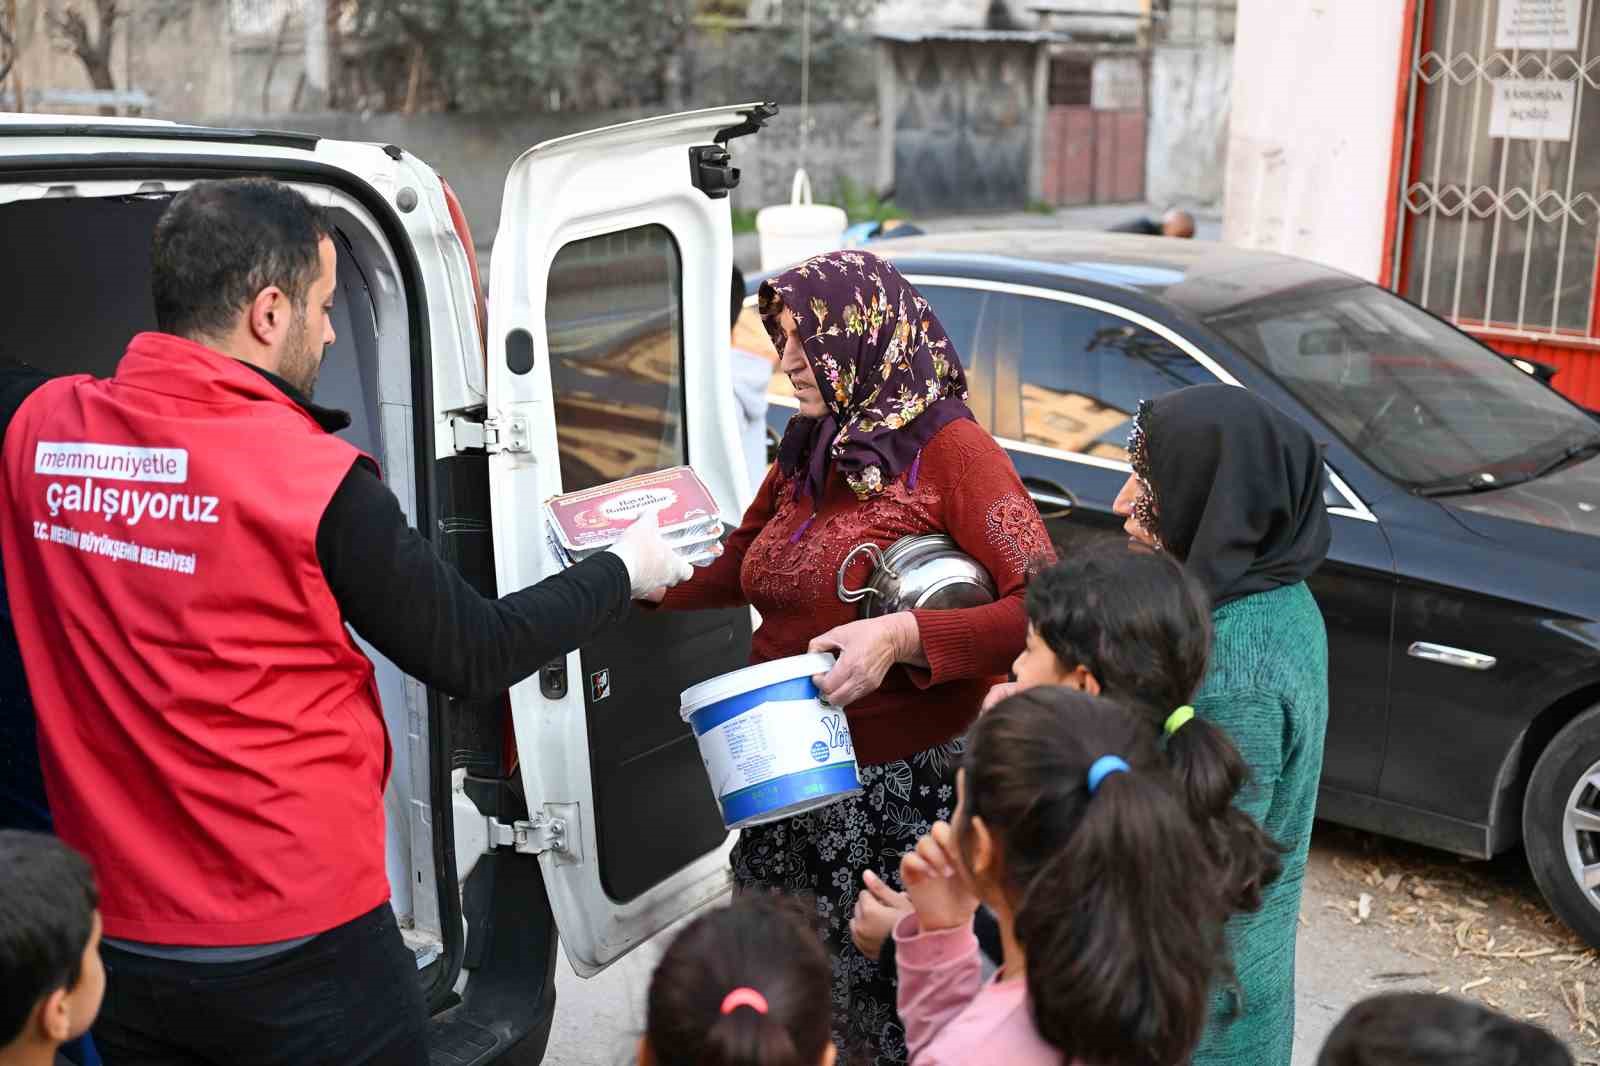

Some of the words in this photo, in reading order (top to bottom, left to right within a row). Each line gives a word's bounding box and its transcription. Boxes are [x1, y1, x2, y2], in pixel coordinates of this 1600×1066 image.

[40, 451, 177, 478] memnuniyetle
[46, 478, 219, 525] çalışıyoruz
[33, 520, 49, 540] T.C.
[79, 531, 139, 563] BÜYÜKŞEHİR
[140, 547, 197, 575] BELEDİYESİ
